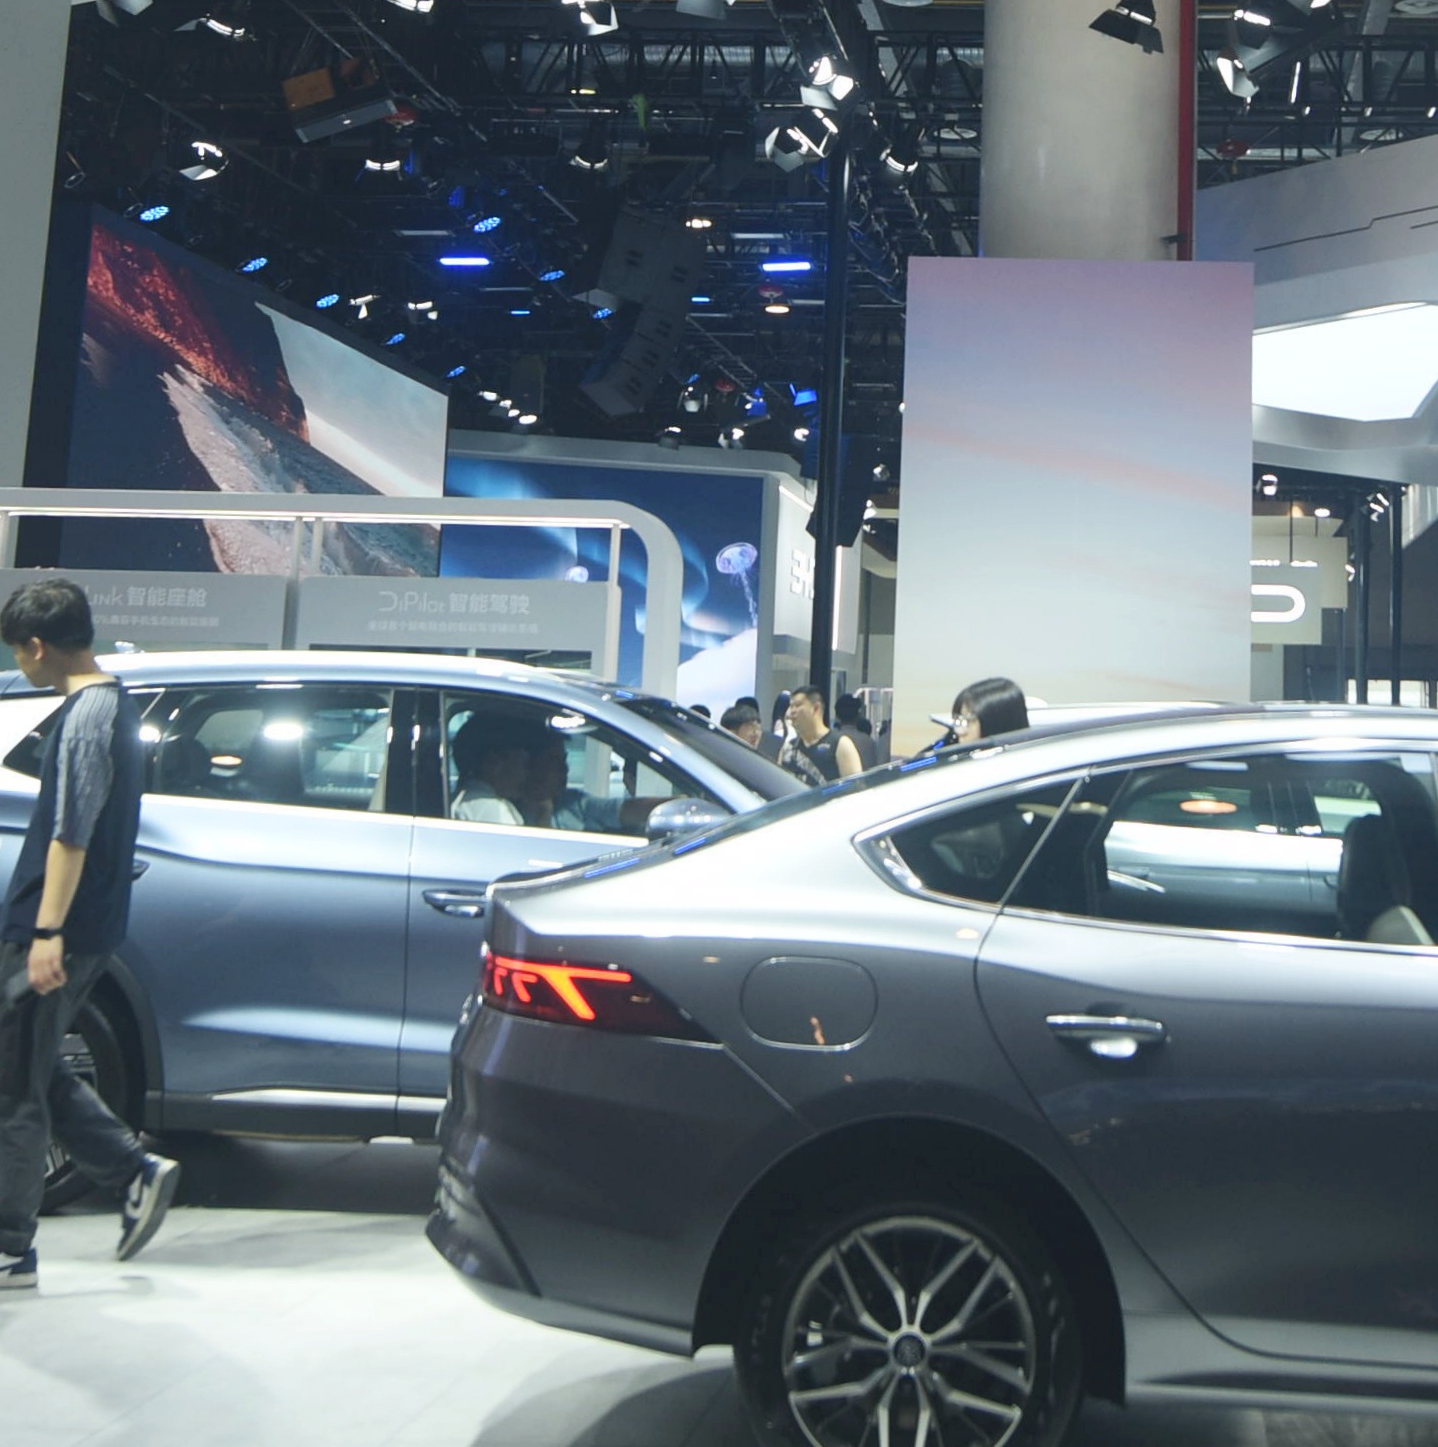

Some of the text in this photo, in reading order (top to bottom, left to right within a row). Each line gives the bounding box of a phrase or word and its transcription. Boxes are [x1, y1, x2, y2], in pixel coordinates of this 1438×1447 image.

[127, 585, 208, 608] 智能座舱
[449, 591, 531, 615] 智能驾驶
